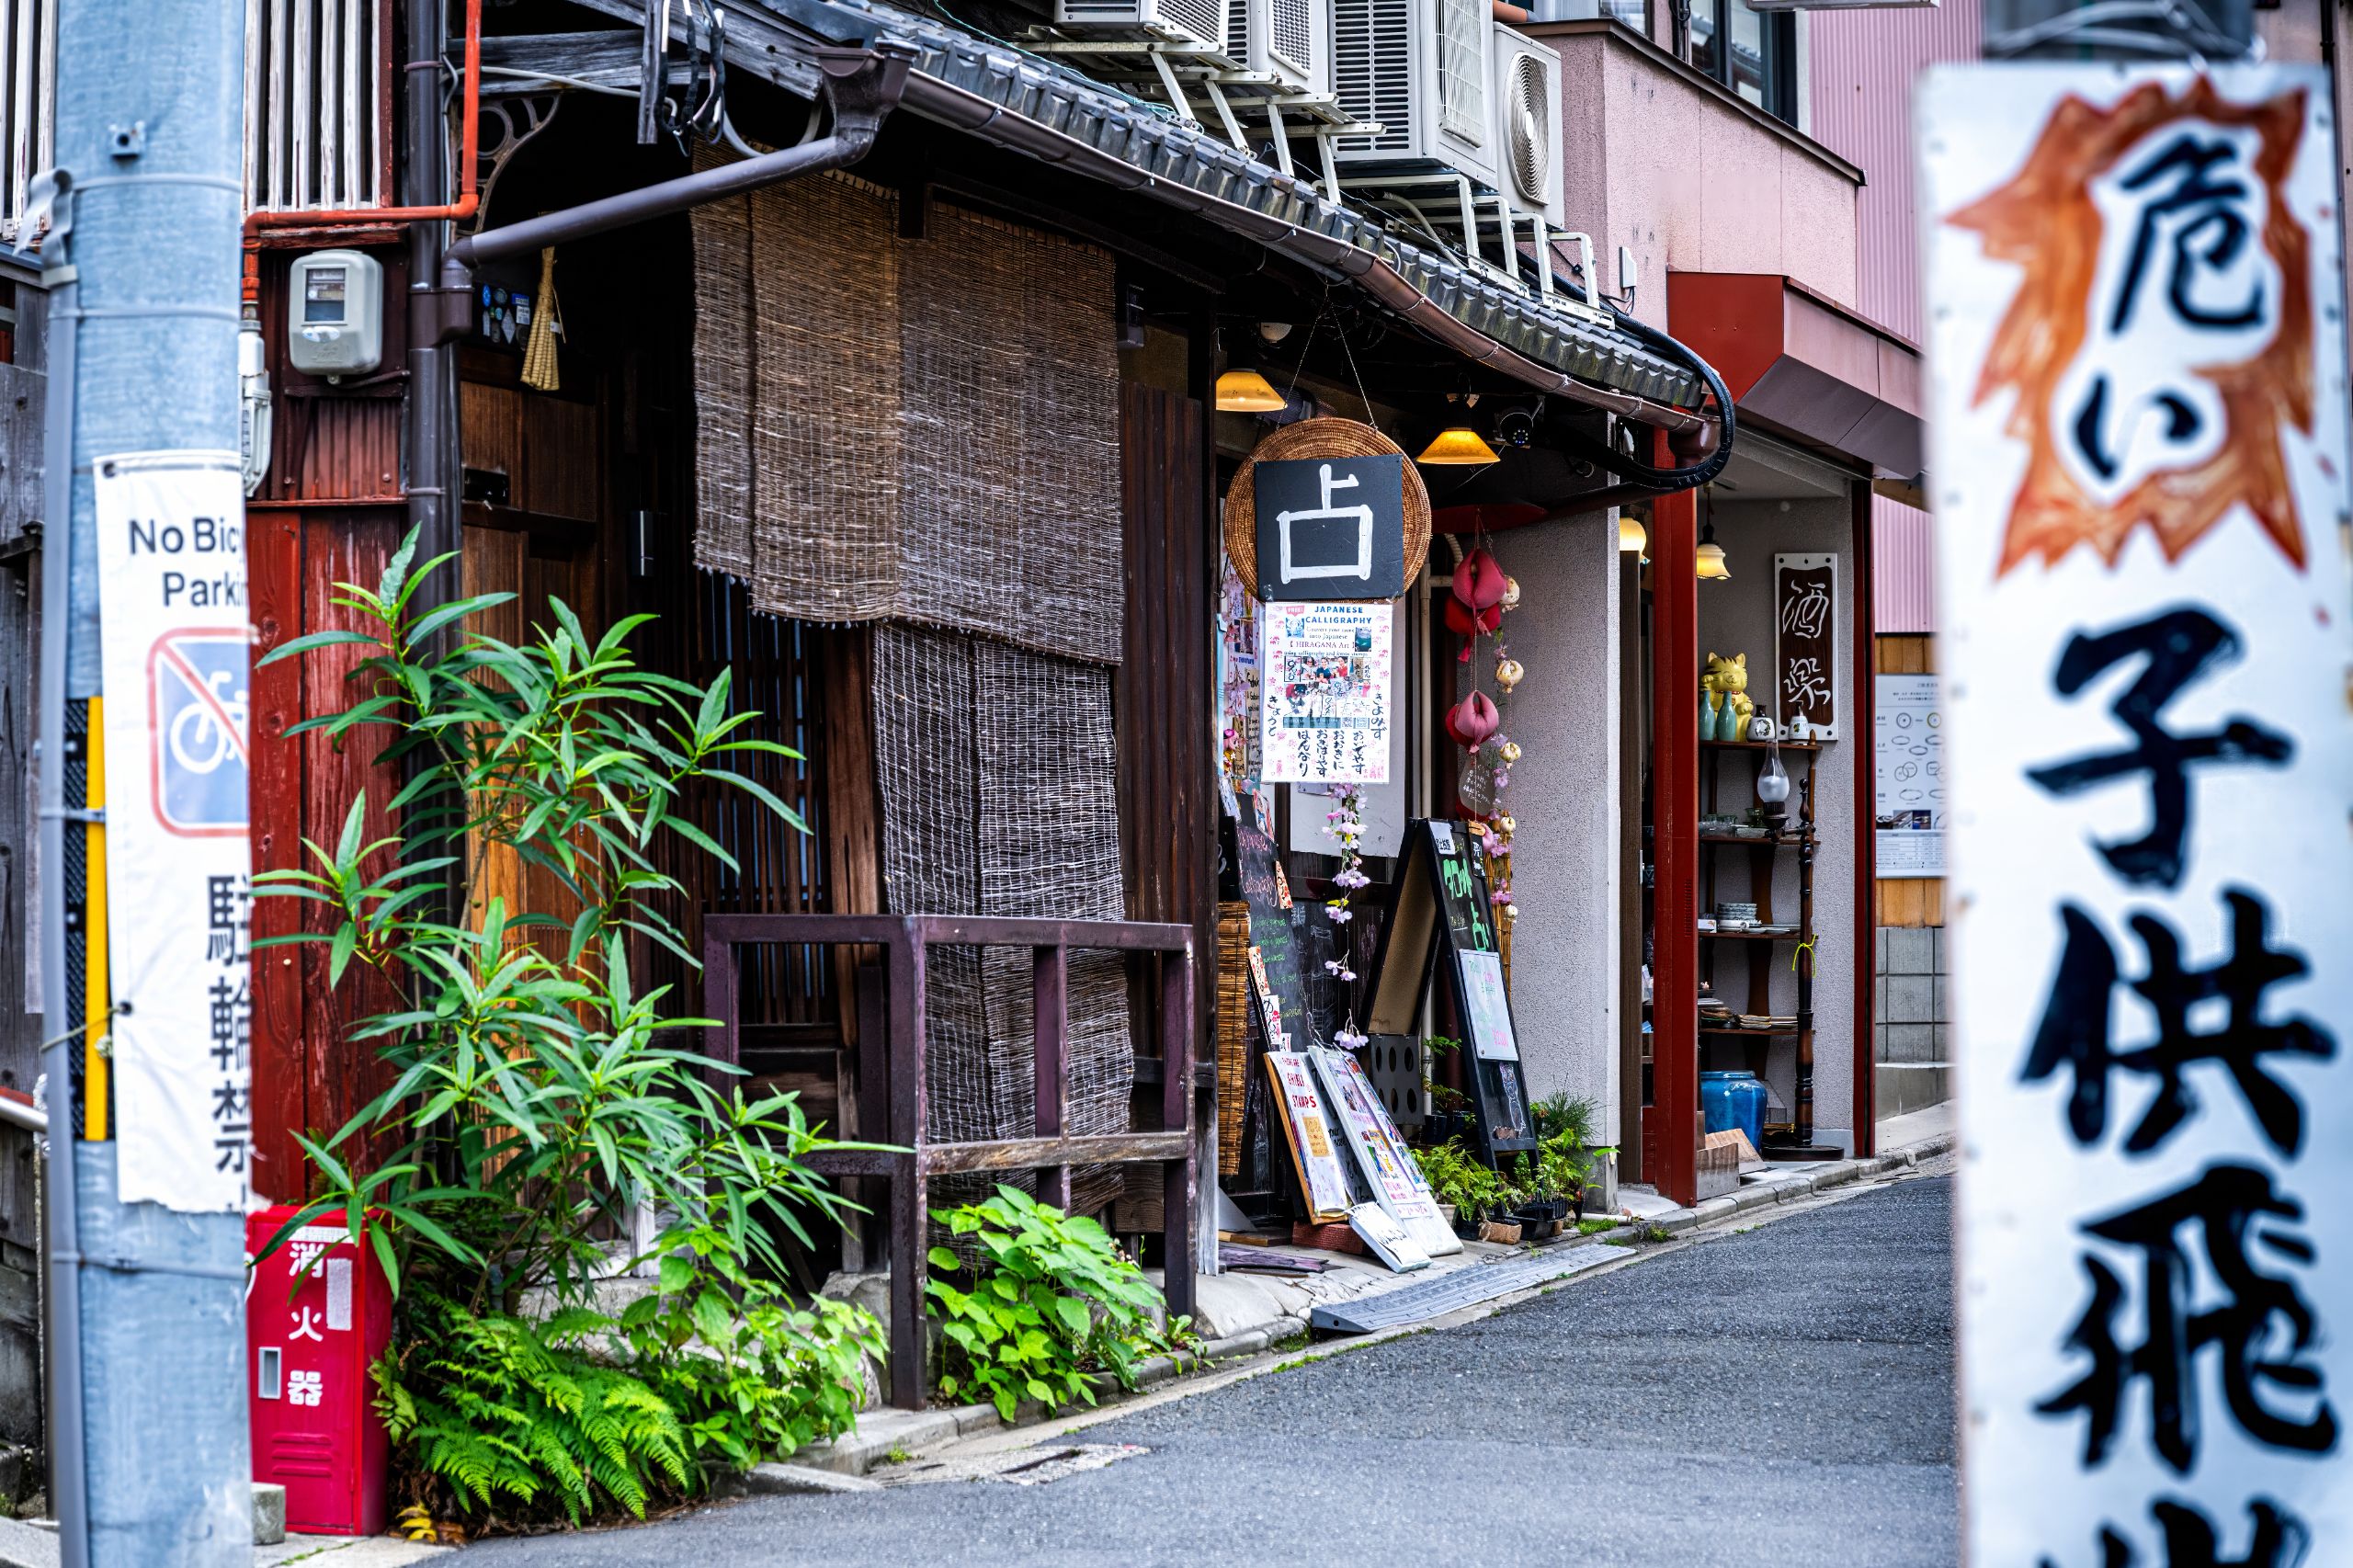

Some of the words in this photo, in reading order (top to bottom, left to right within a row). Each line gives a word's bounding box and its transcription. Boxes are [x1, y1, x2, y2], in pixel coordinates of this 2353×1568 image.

[129, 517, 184, 555] No
[194, 517, 244, 553] Bic
[1276, 463, 1373, 585] 占
[163, 570, 248, 607] Parki
[1305, 616, 1372, 624] CALLIGRAPHY
[1314, 606, 1363, 614] JAPANESE
[1296, 641, 1337, 649] HIRAGANA
[1323, 632, 1347, 641] Japanese
[1298, 730, 1311, 778] はんなり
[1333, 730, 1345, 771] おおきに
[206, 873, 251, 1213] 駐輪禁
[289, 1244, 324, 1407] 消火器
